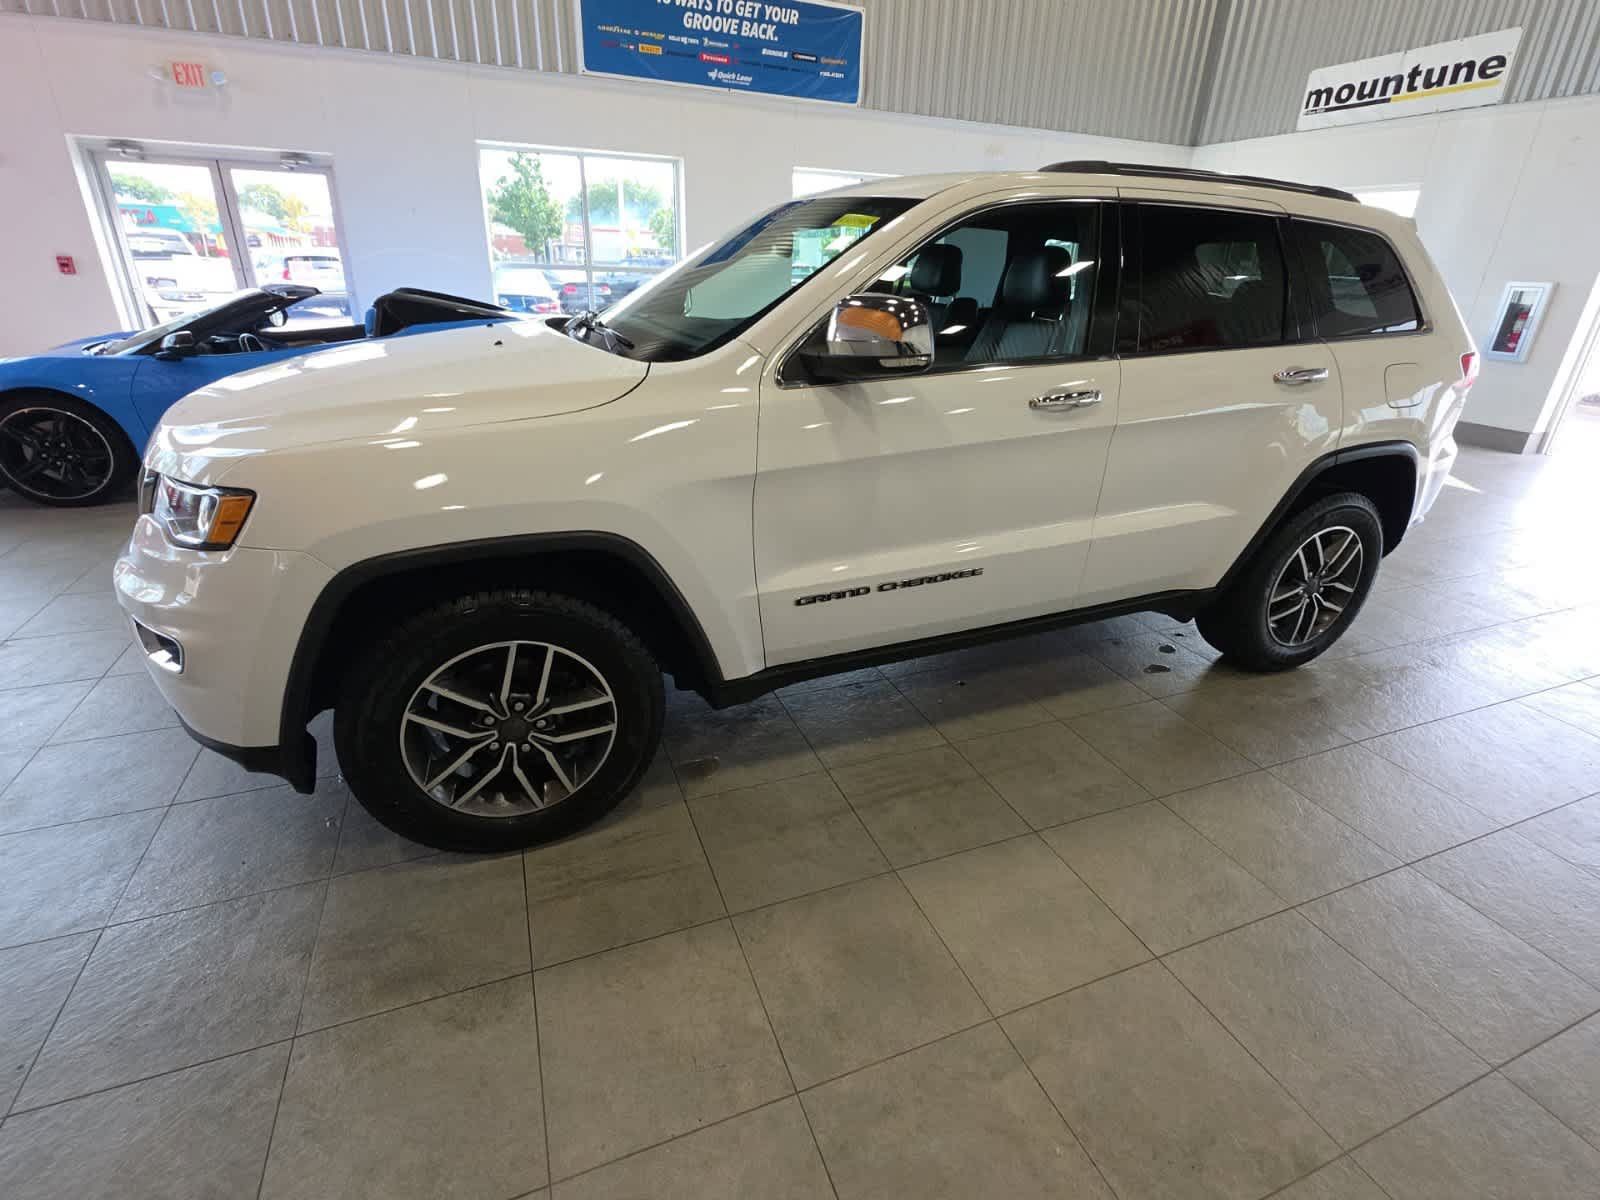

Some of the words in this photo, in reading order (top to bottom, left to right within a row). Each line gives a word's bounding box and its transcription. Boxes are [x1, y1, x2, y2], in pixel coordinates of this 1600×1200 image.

[683, 11, 740, 35] GROOVE
[741, 21, 779, 41] BACK.
[716, 0, 733, 14] TO
[735, 0, 762, 19] GET
[764, 4, 799, 25] YOUR
[172, 62, 205, 88] EXIT
[1304, 54, 1507, 109] mountune
[795, 586, 871, 607] GRAND
[877, 567, 985, 593] CHEROKEE
